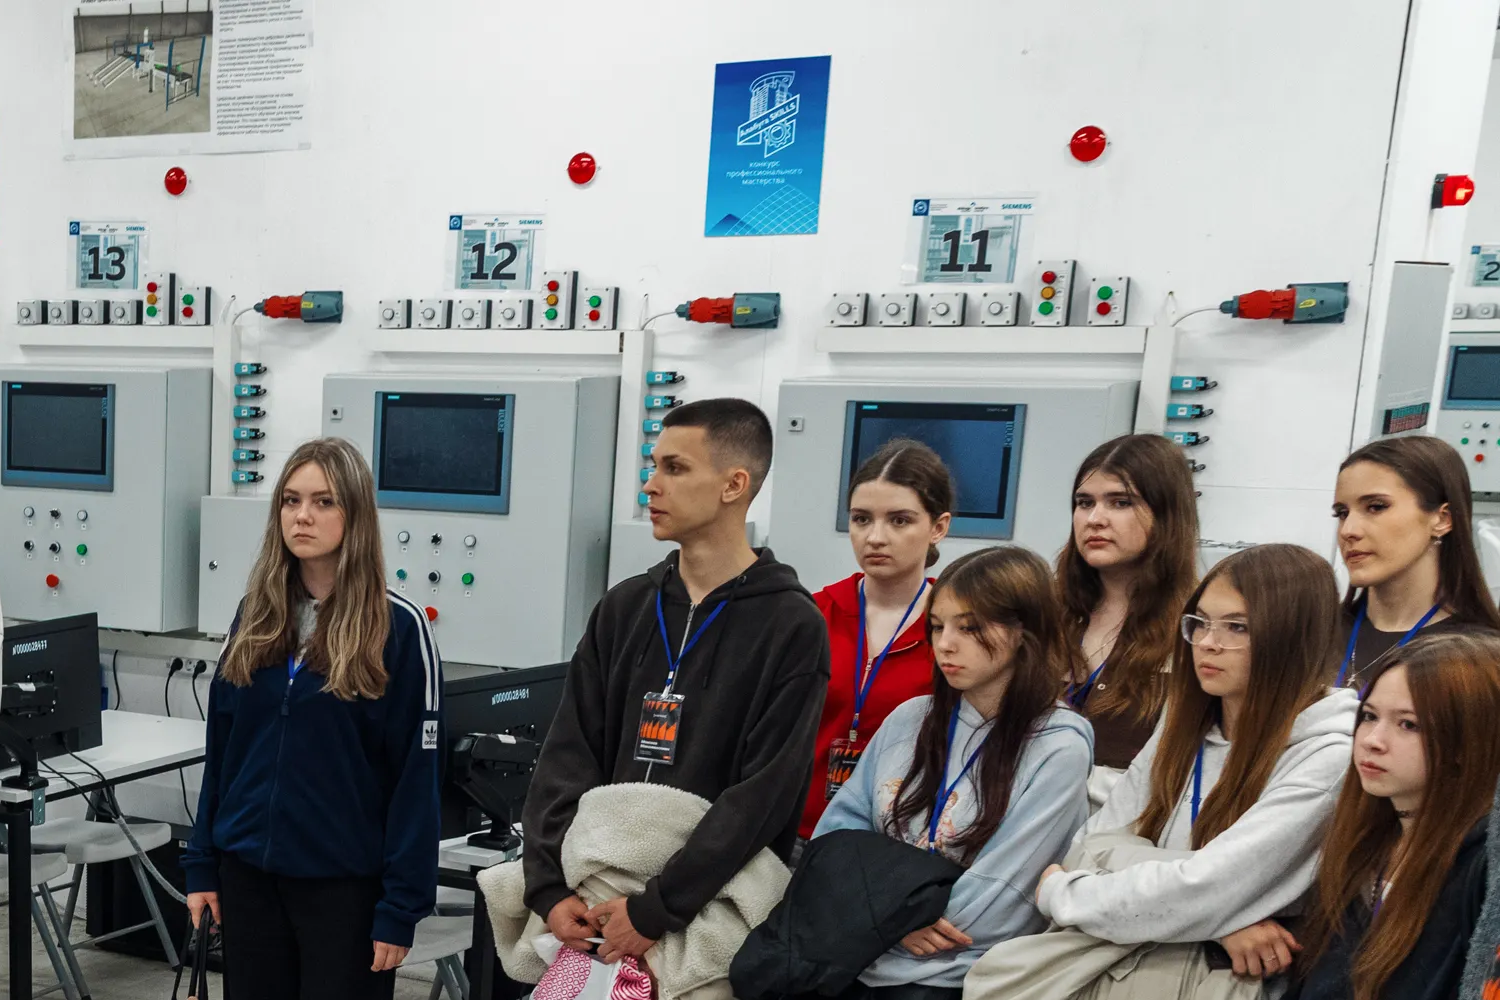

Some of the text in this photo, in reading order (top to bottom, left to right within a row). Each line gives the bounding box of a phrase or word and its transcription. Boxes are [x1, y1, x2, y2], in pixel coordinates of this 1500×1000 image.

[725, 168, 803, 179] профессионального
[749, 160, 780, 169] конкурс
[741, 178, 785, 186] мастерства
[470, 241, 517, 280] 12
[940, 229, 992, 272] 11
[88, 246, 126, 281] 13
